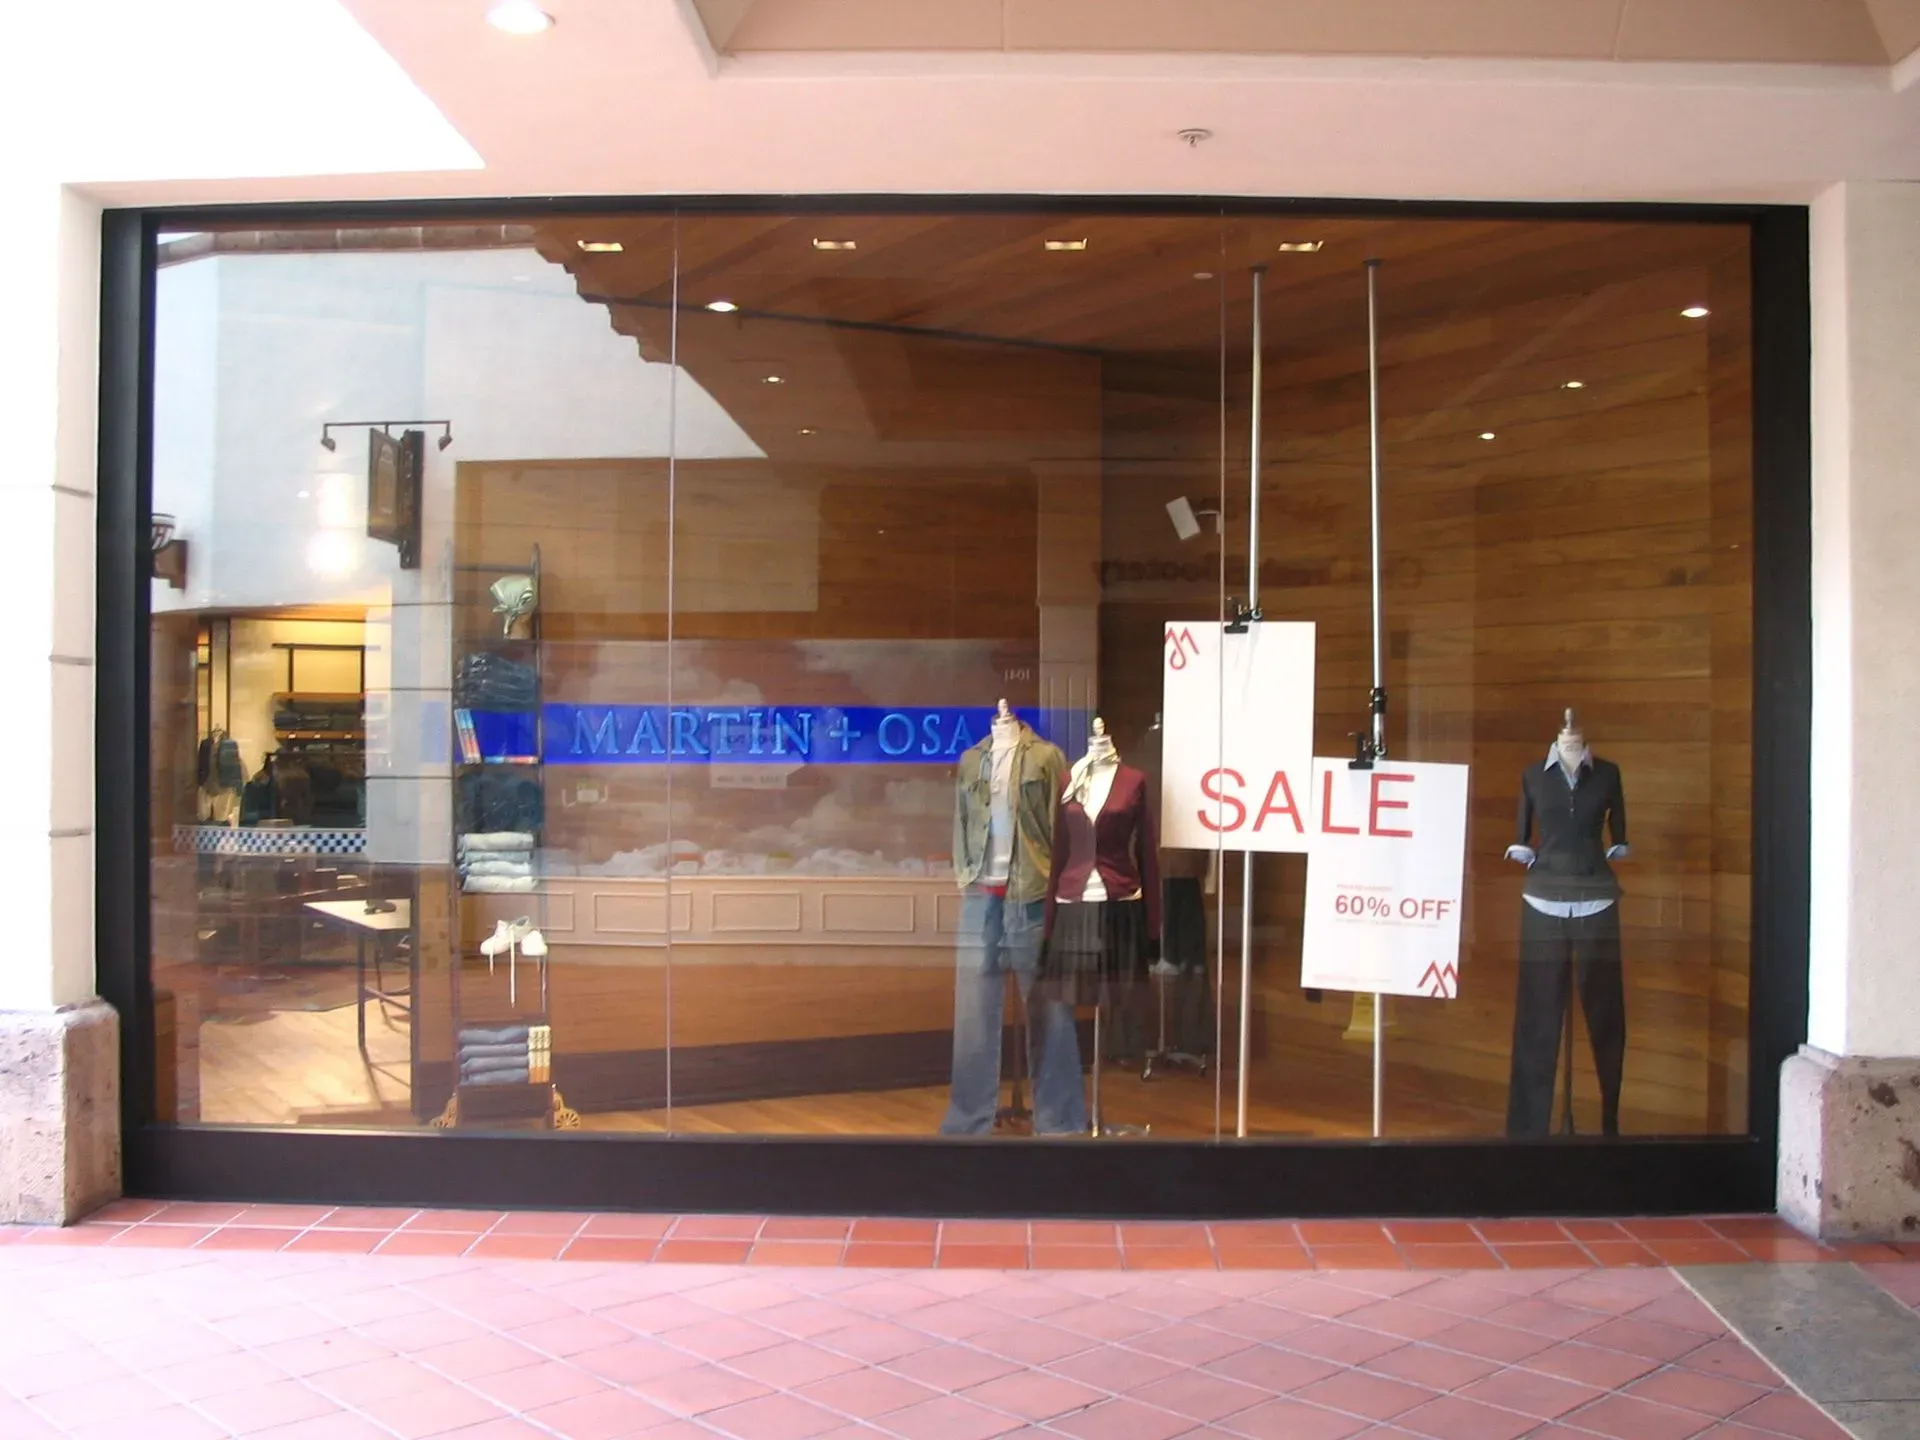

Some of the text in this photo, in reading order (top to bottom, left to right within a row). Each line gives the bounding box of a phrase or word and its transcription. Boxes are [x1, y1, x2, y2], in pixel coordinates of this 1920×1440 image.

[570, 710, 812, 756] MARTIN
[878, 713, 974, 755] OSA
[1197, 767, 1415, 837] SALE
[1335, 894, 1391, 917] 60%
